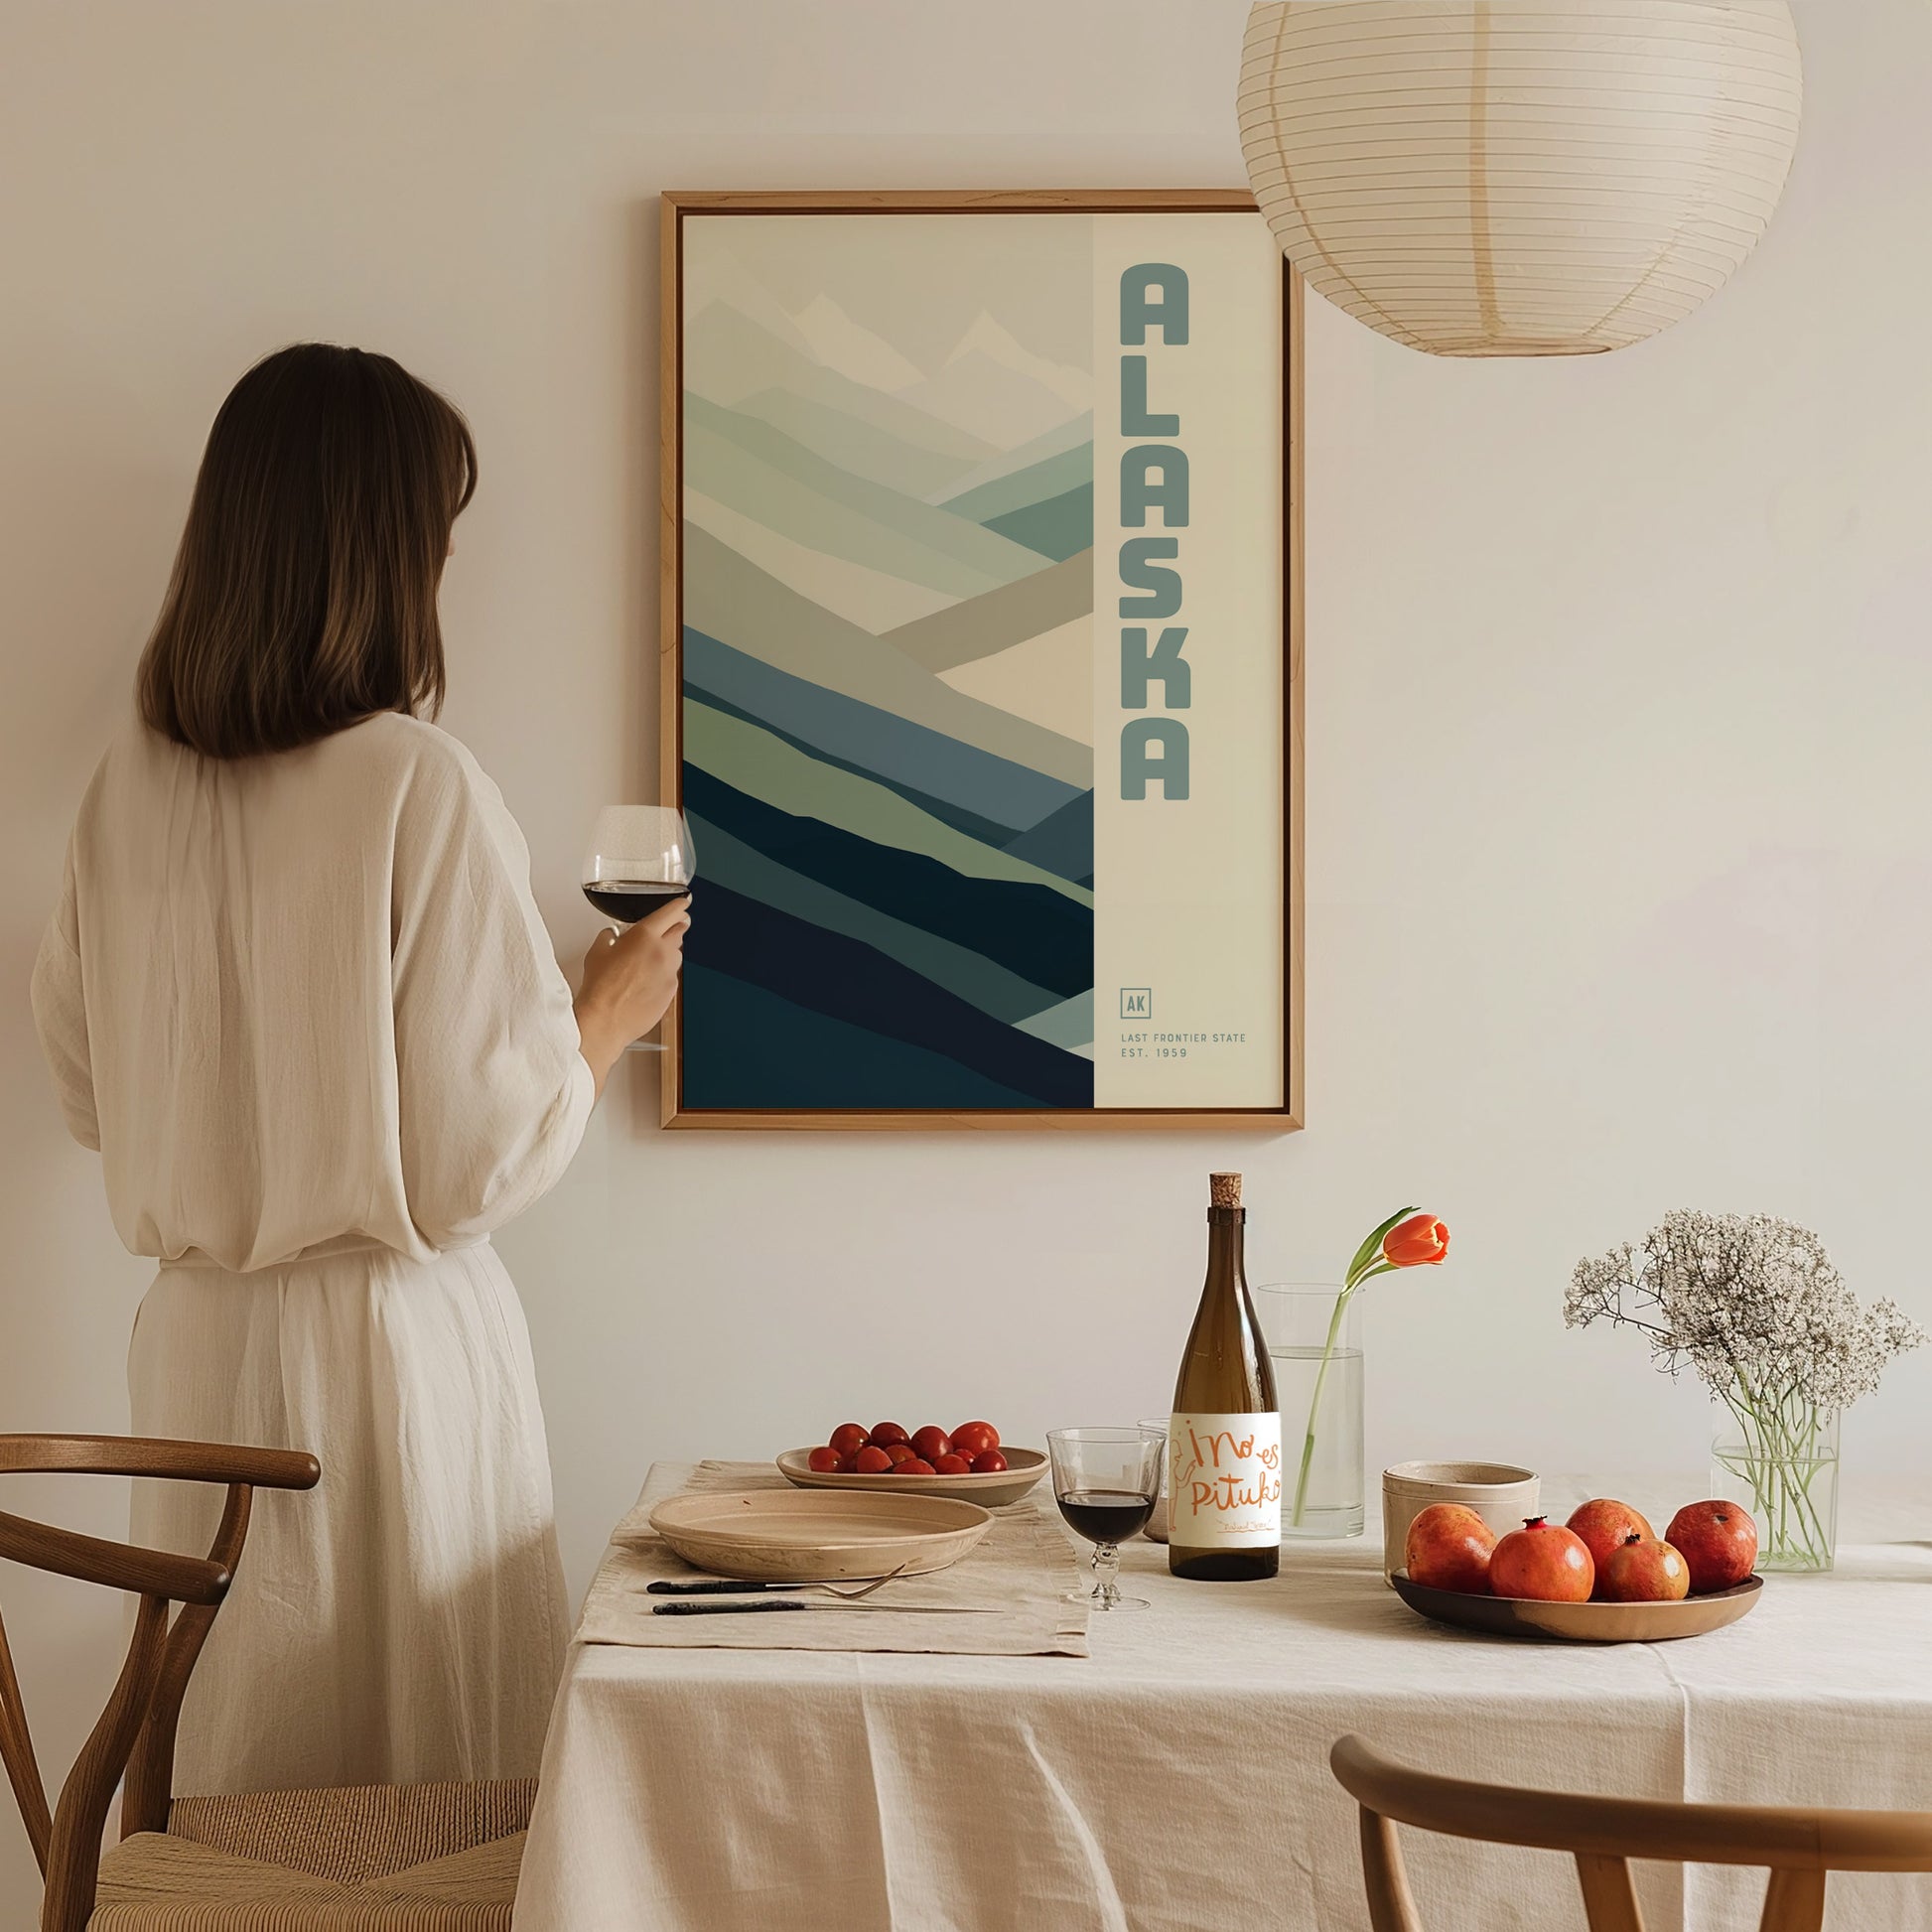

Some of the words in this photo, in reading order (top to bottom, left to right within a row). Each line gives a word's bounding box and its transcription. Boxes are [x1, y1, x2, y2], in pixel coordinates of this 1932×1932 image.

[1118, 262, 1191, 801] ALASKA
[1126, 995, 1146, 1013] AK
[1121, 1033, 1149, 1042] LAST
[1153, 1033, 1207, 1042] FRONTIER
[1212, 1033, 1246, 1042] STATE
[1121, 1047, 1149, 1058] EST.
[1157, 1047, 1187, 1058] 1959
[1256, 1444, 1279, 1470] es
